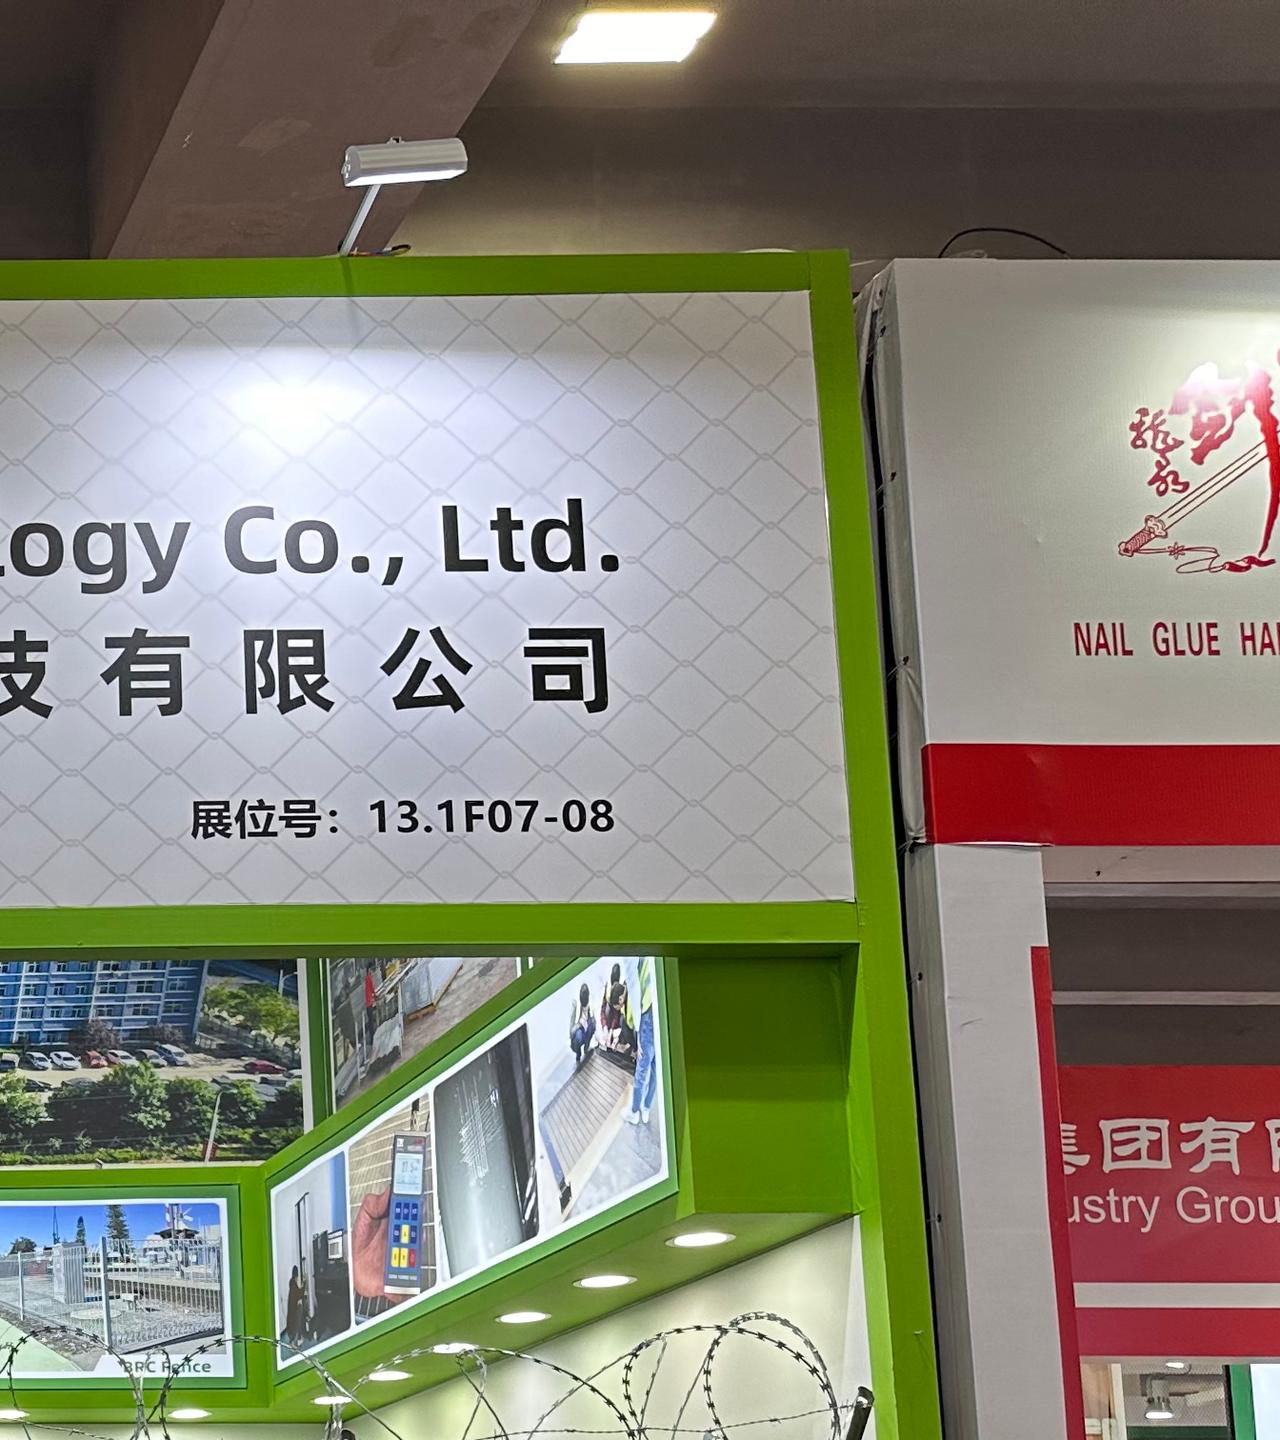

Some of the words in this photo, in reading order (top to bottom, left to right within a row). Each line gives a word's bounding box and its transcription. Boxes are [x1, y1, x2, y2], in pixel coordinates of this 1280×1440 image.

[224, 506, 404, 586] Co.,
[442, 498, 620, 573] Ltd.
[1074, 622, 1134, 656] NAIL
[1152, 622, 1221, 656] GLUE
[1240, 622, 1280, 656] HA
[369, 798, 615, 835] 13.1F07-08
[1061, 1116, 1280, 1175] 团有
[161, 1361, 212, 1373] Fence
